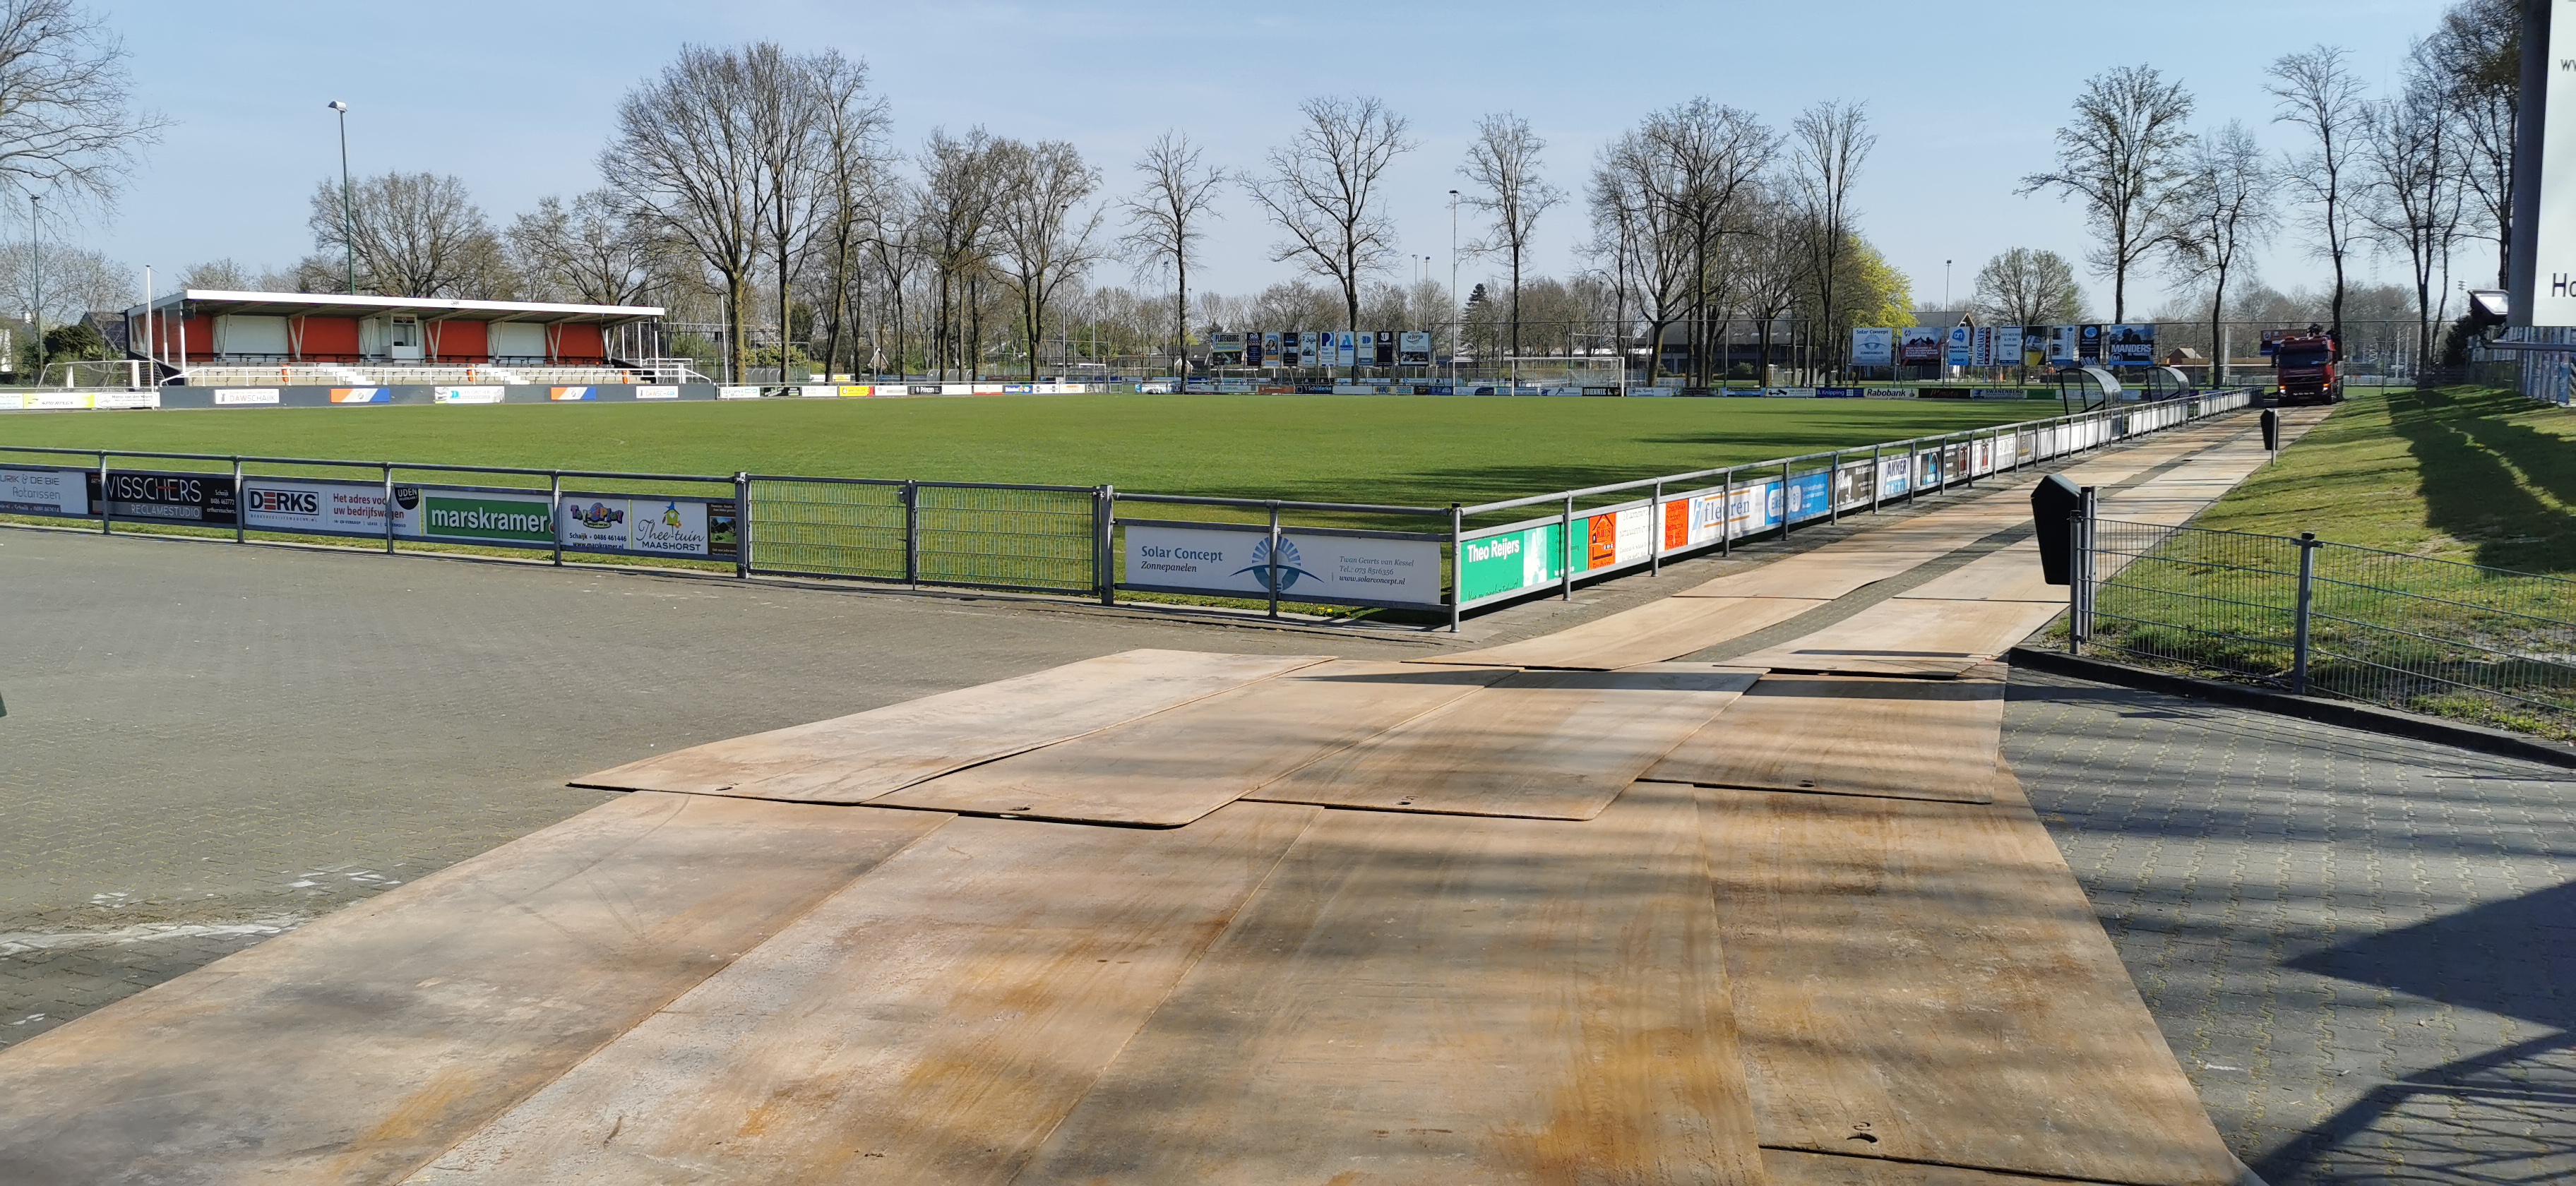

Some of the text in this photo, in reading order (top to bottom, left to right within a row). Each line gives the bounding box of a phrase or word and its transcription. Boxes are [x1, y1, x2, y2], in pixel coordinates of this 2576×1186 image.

[1976, 327, 1985, 364] PLOEGMAKERS
[2111, 345, 2152, 353] MANDERS
[1887, 459, 1907, 478] AKKER
[45, 477, 60, 486] BIE
[106, 476, 202, 503] VISSCHERS
[398, 489, 417, 498] UDEN
[250, 491, 318, 513] DERKS
[333, 493, 347, 503] Het
[348, 494, 371, 504] adres
[131, 504, 200, 517] RECLAMESTUDIO
[333, 507, 345, 515] uw
[1704, 500, 1750, 522] fleren
[431, 507, 547, 532] marskramer
[569, 532, 588, 541] Schaijk
[636, 519, 705, 542] Thee-tuin
[642, 541, 701, 551] MAASHORST
[1467, 537, 1520, 563] Theo Reijers
[1141, 546, 1223, 563] Solar Concept
[1140, 561, 1197, 573] Zonnepanelen
[1367, 567, 1394, 576] 8516356
[1339, 575, 1406, 586] www.solarconcept.nl
